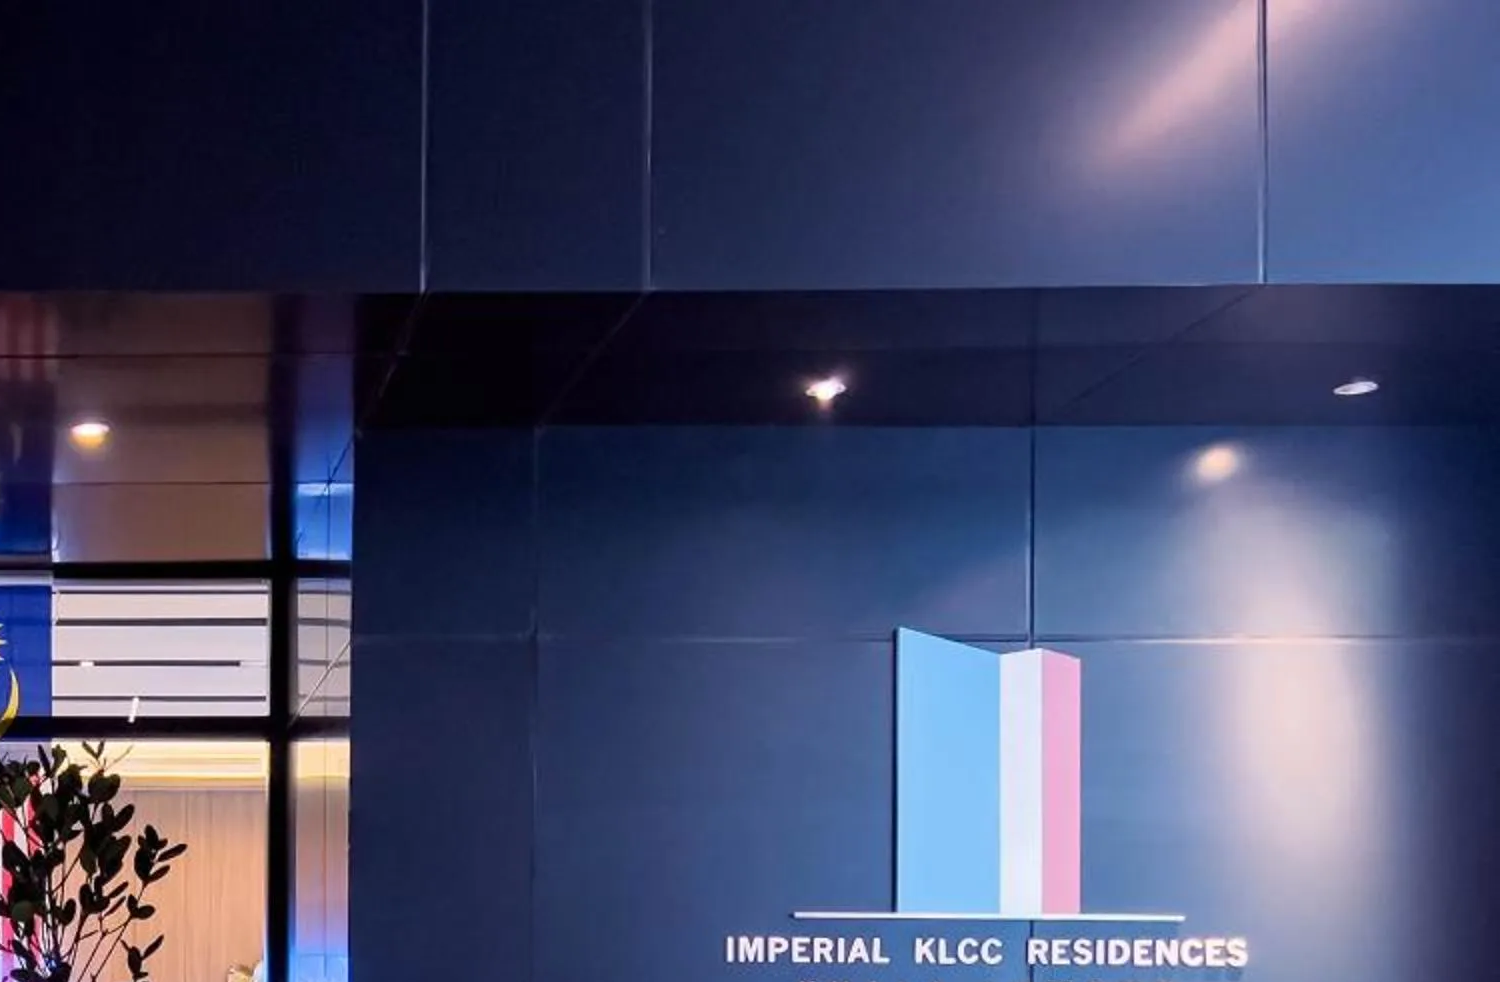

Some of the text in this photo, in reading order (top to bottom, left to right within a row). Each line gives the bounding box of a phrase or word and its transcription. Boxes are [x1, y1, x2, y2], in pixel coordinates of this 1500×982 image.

[726, 936, 1249, 967] IMPERIAL KLCC RESIDENCES
